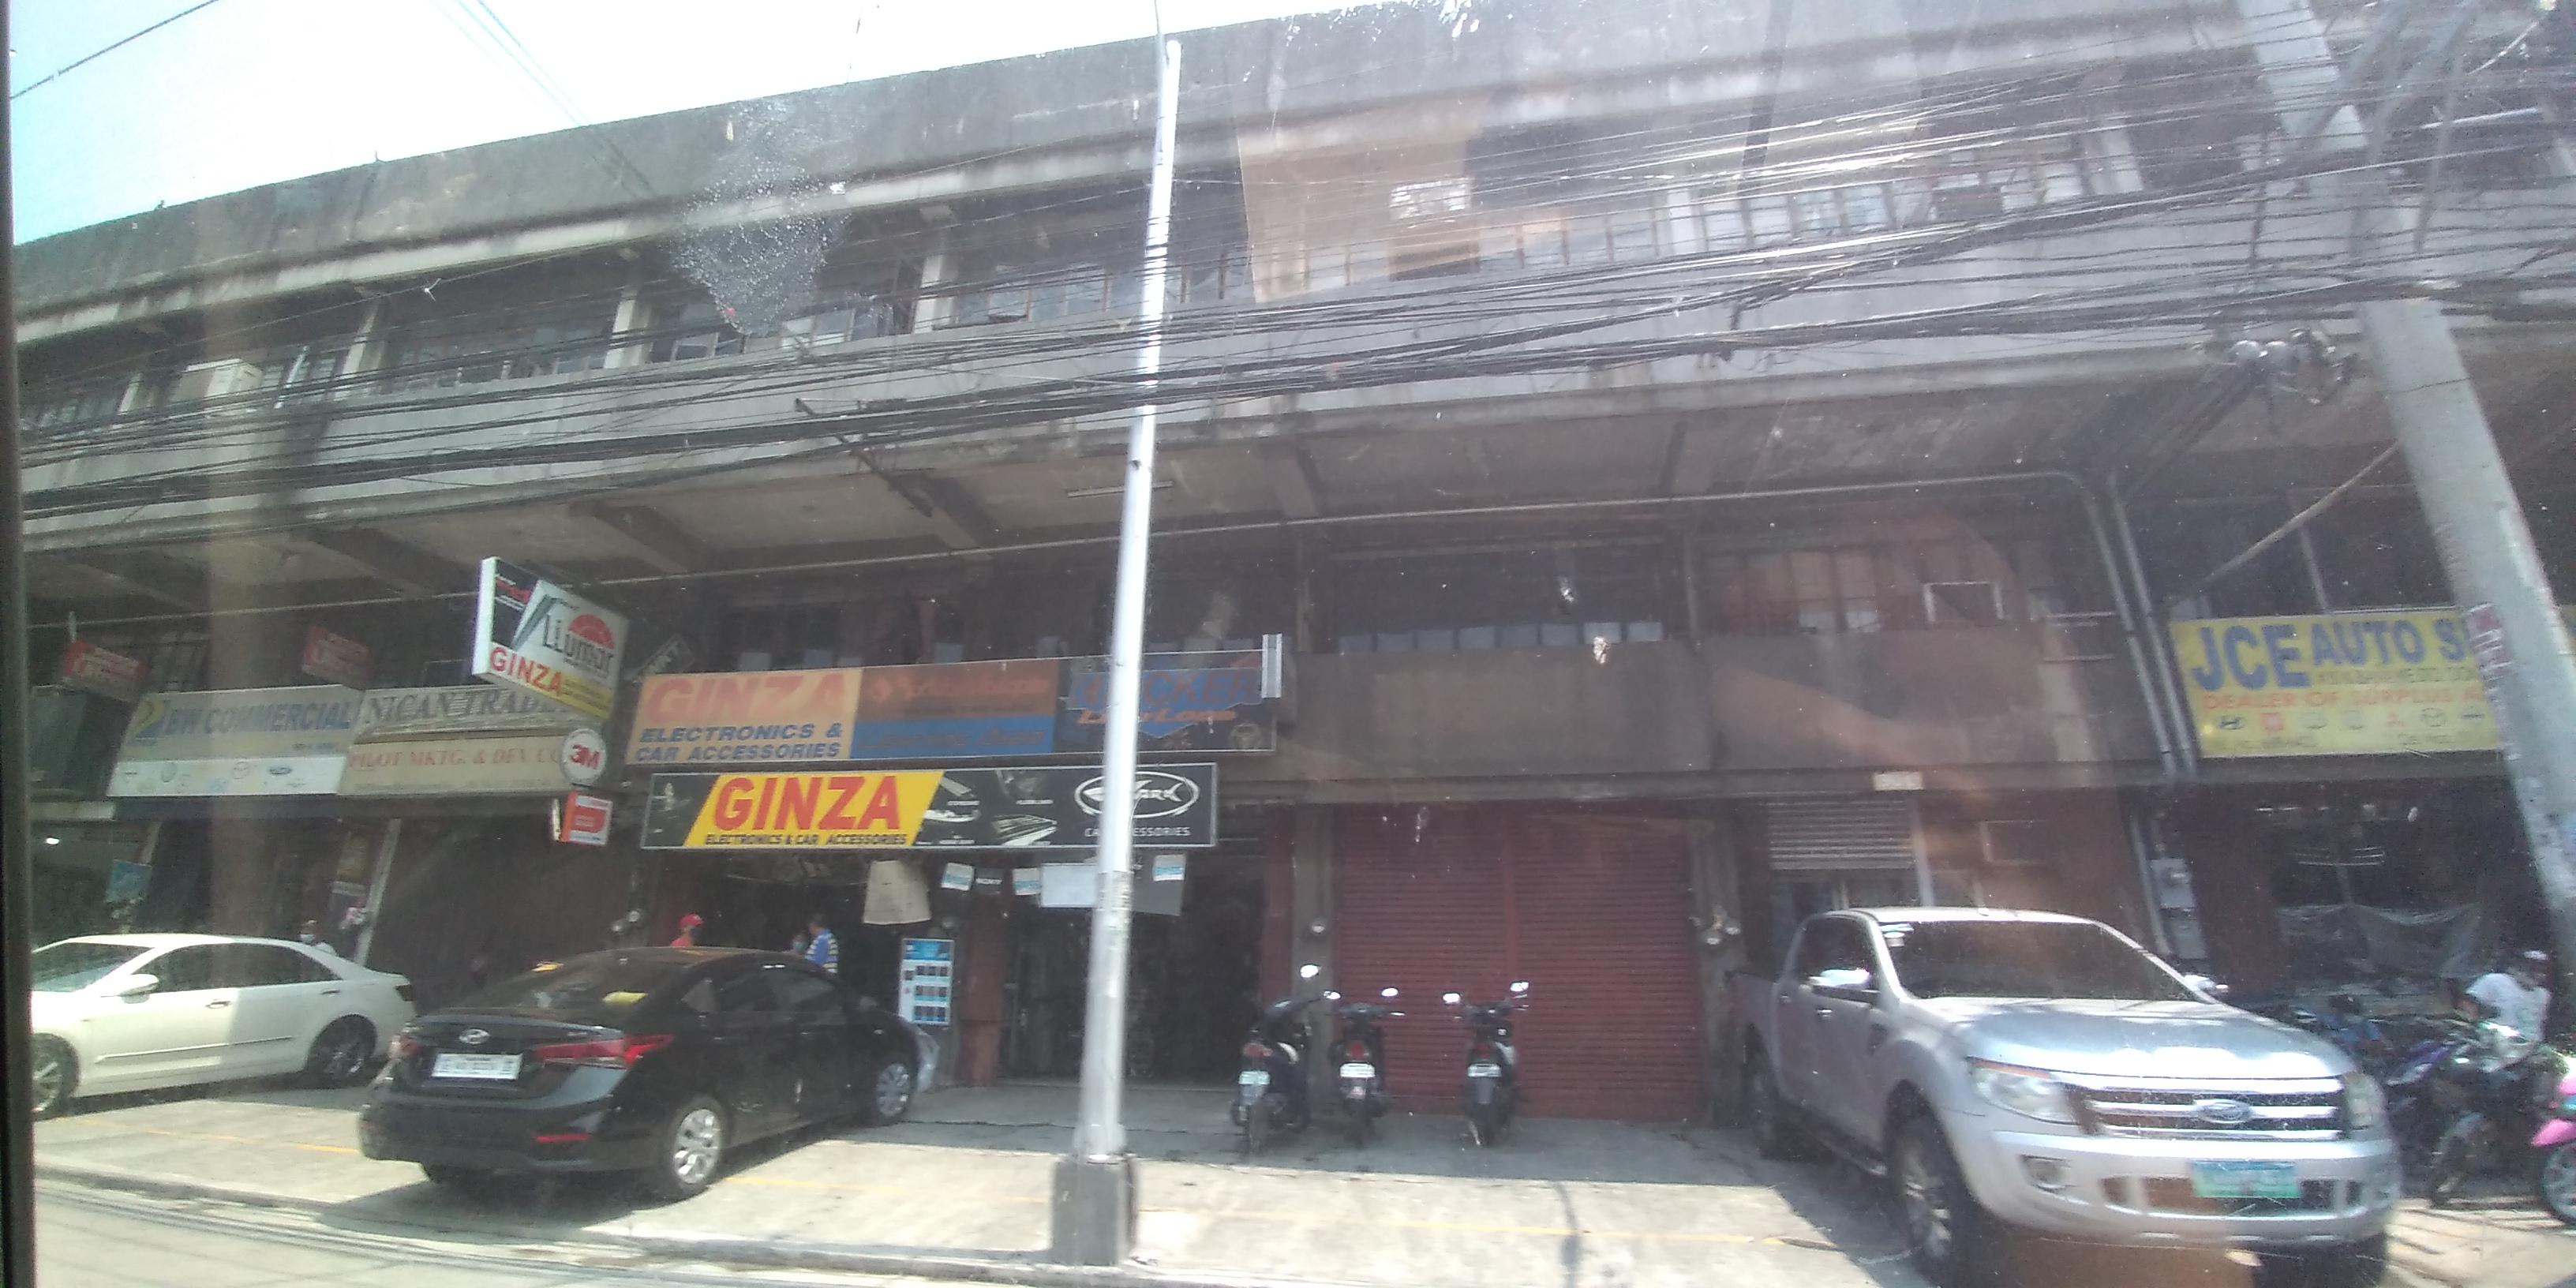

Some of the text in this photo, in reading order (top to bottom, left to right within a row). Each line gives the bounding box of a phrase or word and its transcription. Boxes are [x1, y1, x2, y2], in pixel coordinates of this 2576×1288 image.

[490, 646, 563, 696] GINZA
[2191, 624, 2311, 691] JCE
[2312, 620, 2425, 666] AUTO
[646, 673, 845, 724] GINZA
[1074, 672, 1259, 706] KCKER
[2203, 692, 2297, 709] DEALER
[2305, 690, 2339, 706] OF
[203, 702, 352, 734] COMMERCIAL
[640, 723, 814, 743] ELECTRONICS
[826, 722, 843, 739] &
[571, 744, 601, 769] 3M
[635, 743, 841, 762] CAR ACCESSORIES
[714, 775, 900, 831] GINZA
[705, 833, 782, 845] ELECTRONICS
[826, 833, 908, 845] ACCESSORIES
